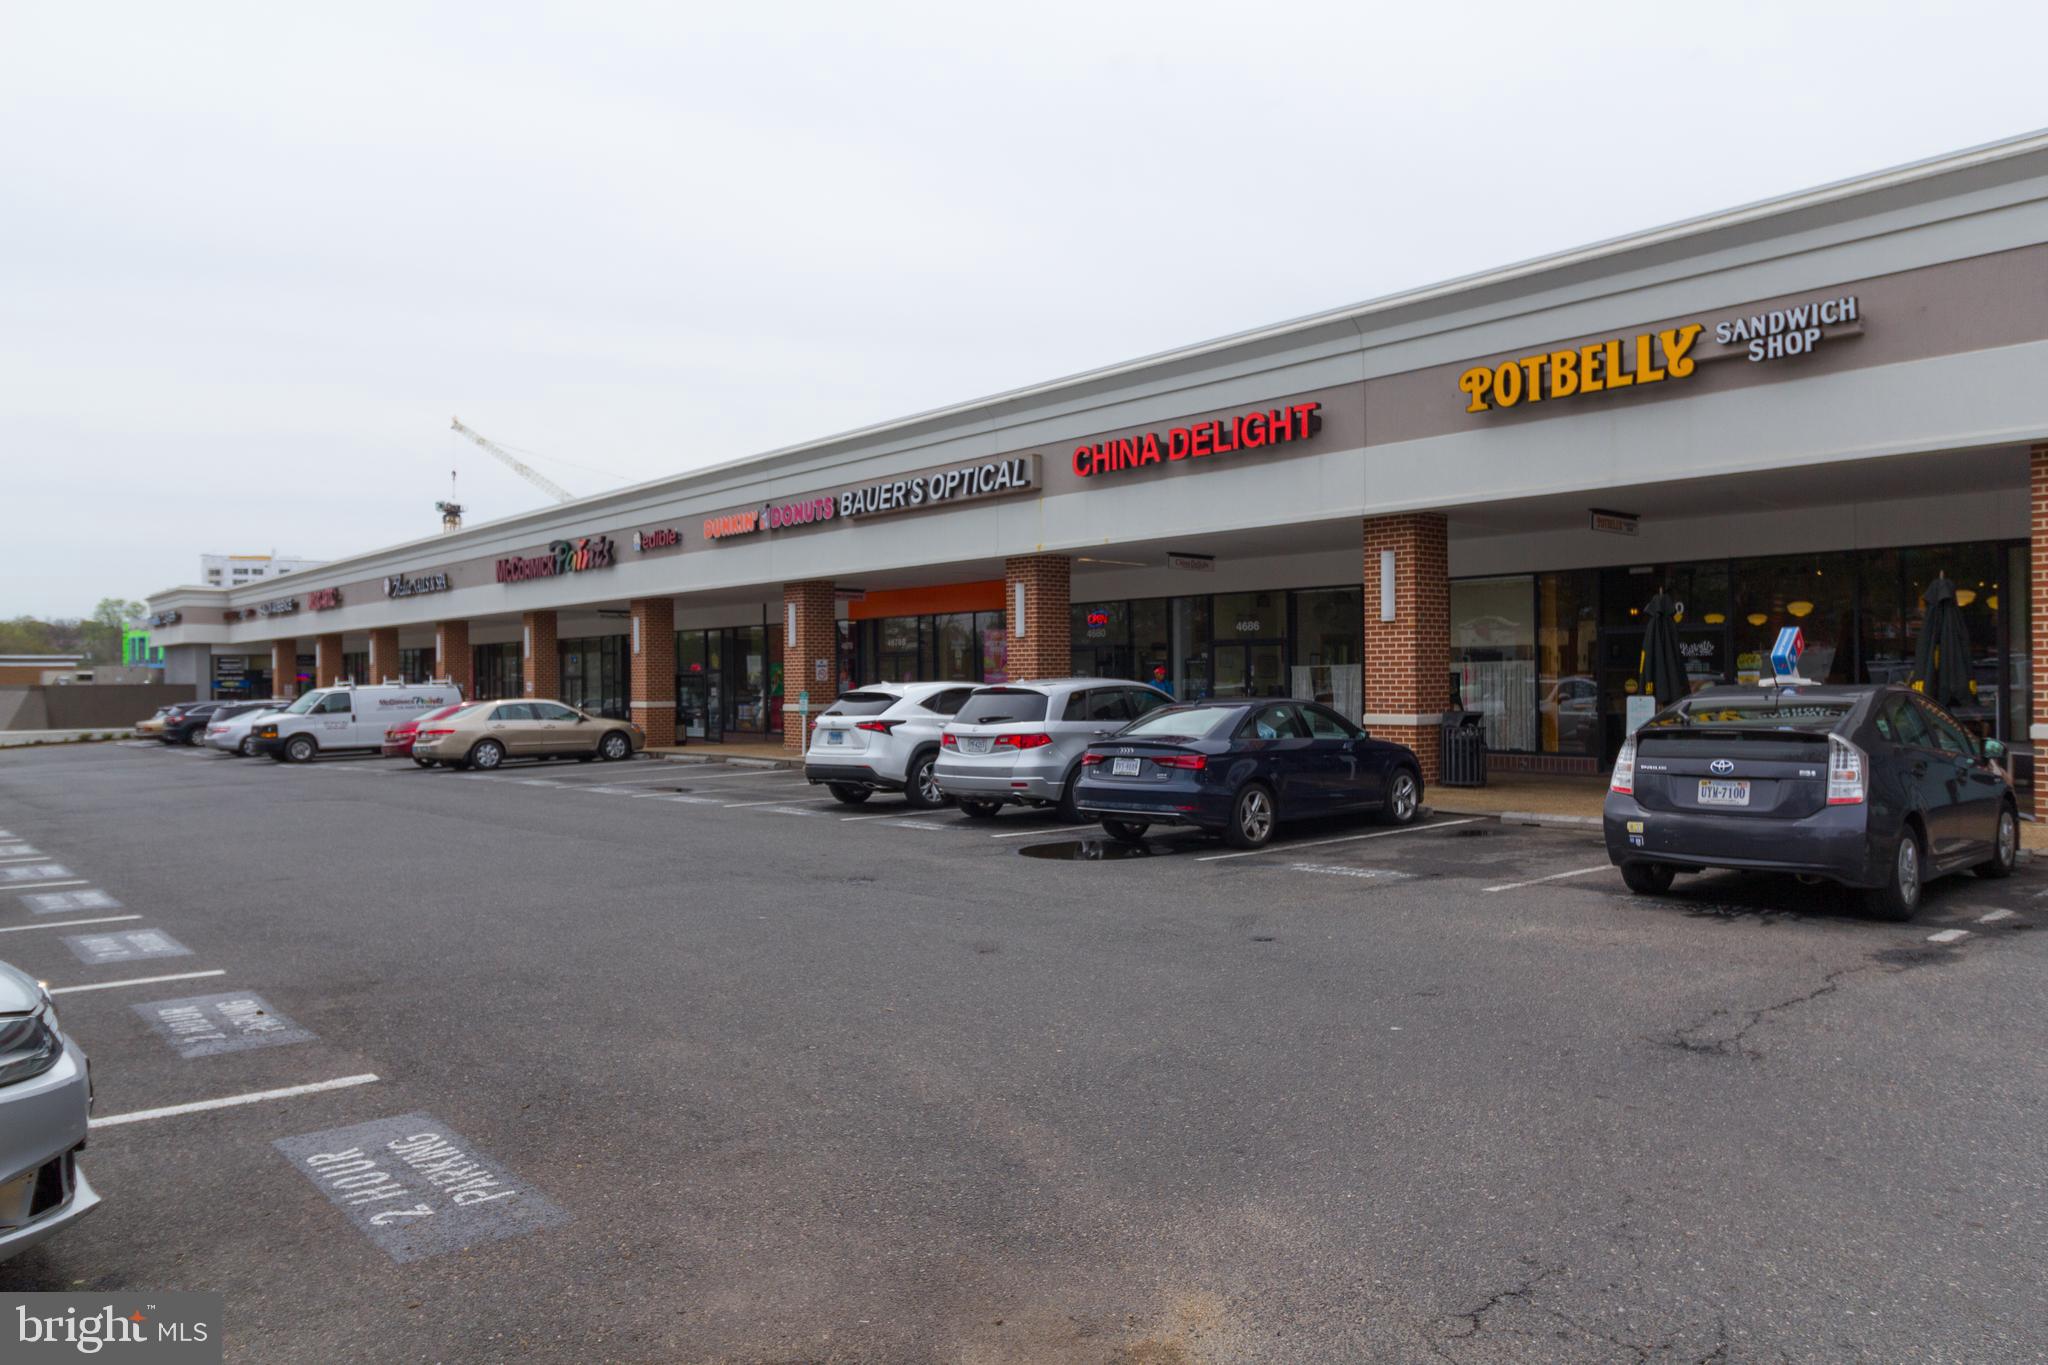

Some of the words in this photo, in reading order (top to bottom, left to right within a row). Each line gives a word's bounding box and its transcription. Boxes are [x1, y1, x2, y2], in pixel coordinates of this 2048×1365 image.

[1716, 296, 1857, 344] SANDWICH
[1748, 327, 1821, 362] SHOP
[1458, 323, 1704, 413] POTBELLY
[1072, 433, 1160, 477] CHINA
[1168, 402, 1318, 461] DELIGHT
[840, 477, 924, 517] BAUER'S
[929, 459, 1026, 500] OPTICAL
[641, 527, 677, 549] edible
[703, 510, 759, 540] DUNKIN'
[770, 496, 834, 529] DONUTS
[549, 536, 615, 575] Paints
[1087, 613, 1109, 625] OPEN
[306, 1147, 409, 1206] HOUR
[386, 1132, 516, 1207] PARKING
[369, 1203, 435, 1226] 2
